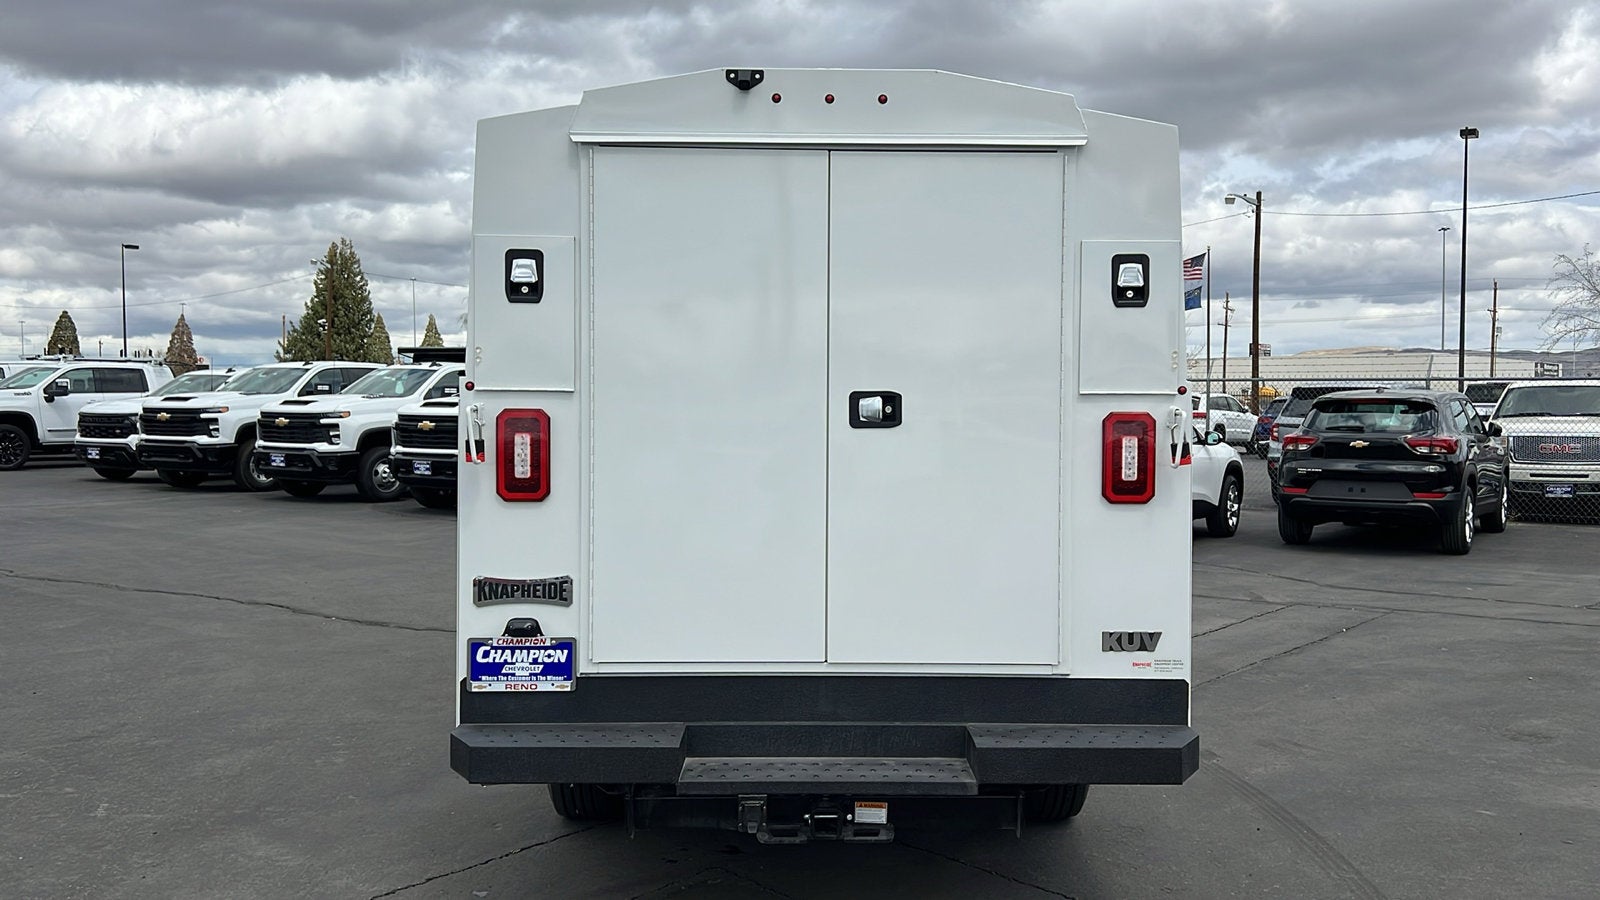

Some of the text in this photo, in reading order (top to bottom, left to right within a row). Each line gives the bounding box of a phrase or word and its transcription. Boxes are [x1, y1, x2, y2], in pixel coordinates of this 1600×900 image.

[1539, 443, 1581, 453] GMC
[477, 580, 569, 602] KNAPHEIDE
[496, 638, 547, 646] CHAMPION
[1101, 631, 1162, 652] KUV
[476, 646, 568, 663] CHAMPION
